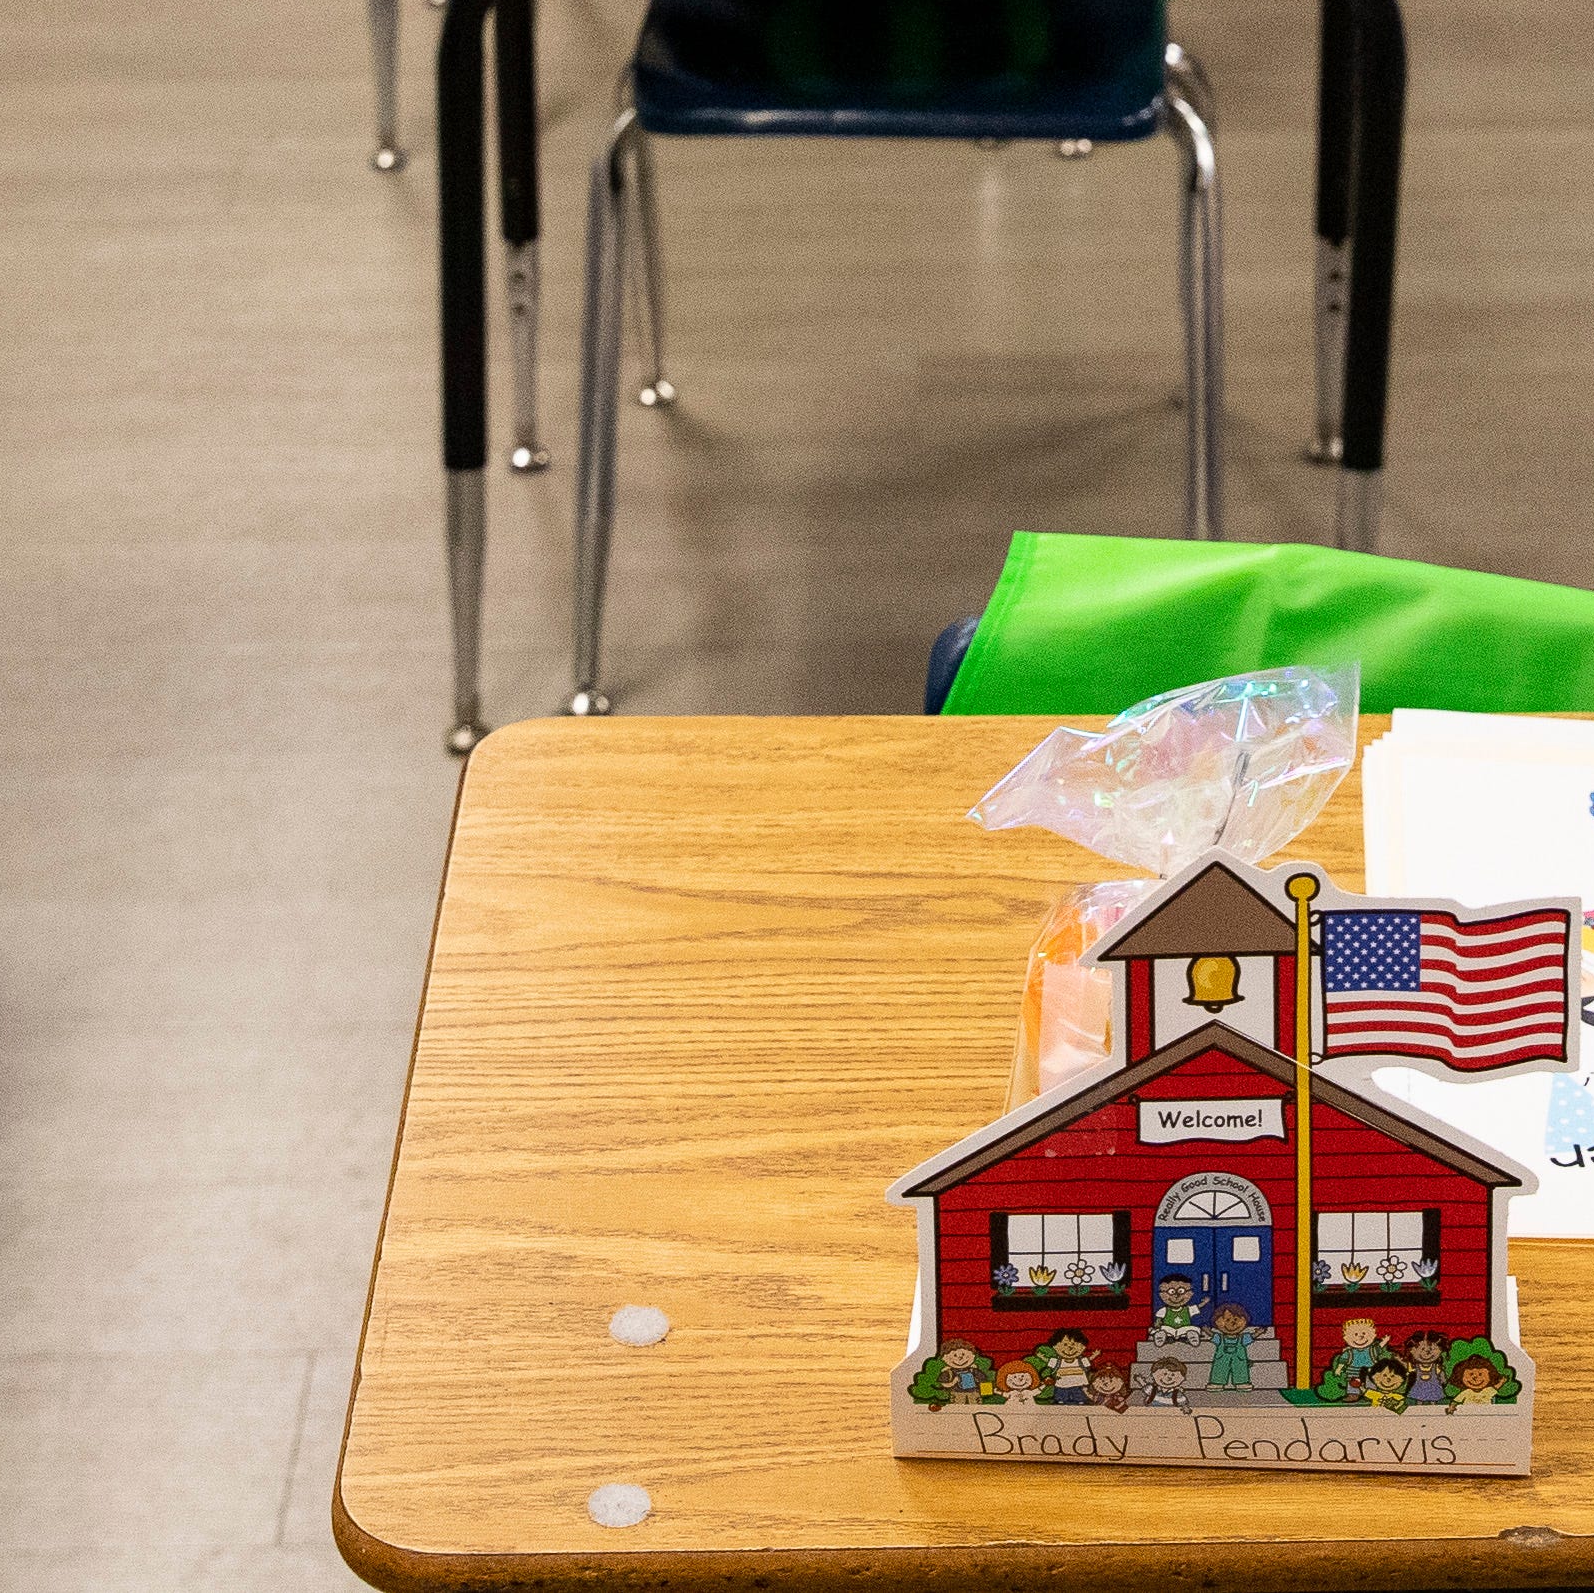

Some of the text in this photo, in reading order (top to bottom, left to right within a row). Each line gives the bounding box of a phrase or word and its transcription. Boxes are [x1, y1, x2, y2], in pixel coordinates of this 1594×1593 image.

[1157, 1109, 1263, 1128] Welcome!
[1158, 1176, 1266, 1223] Really Good School House
[971, 1411, 1458, 1466] Brady Pendarvis
